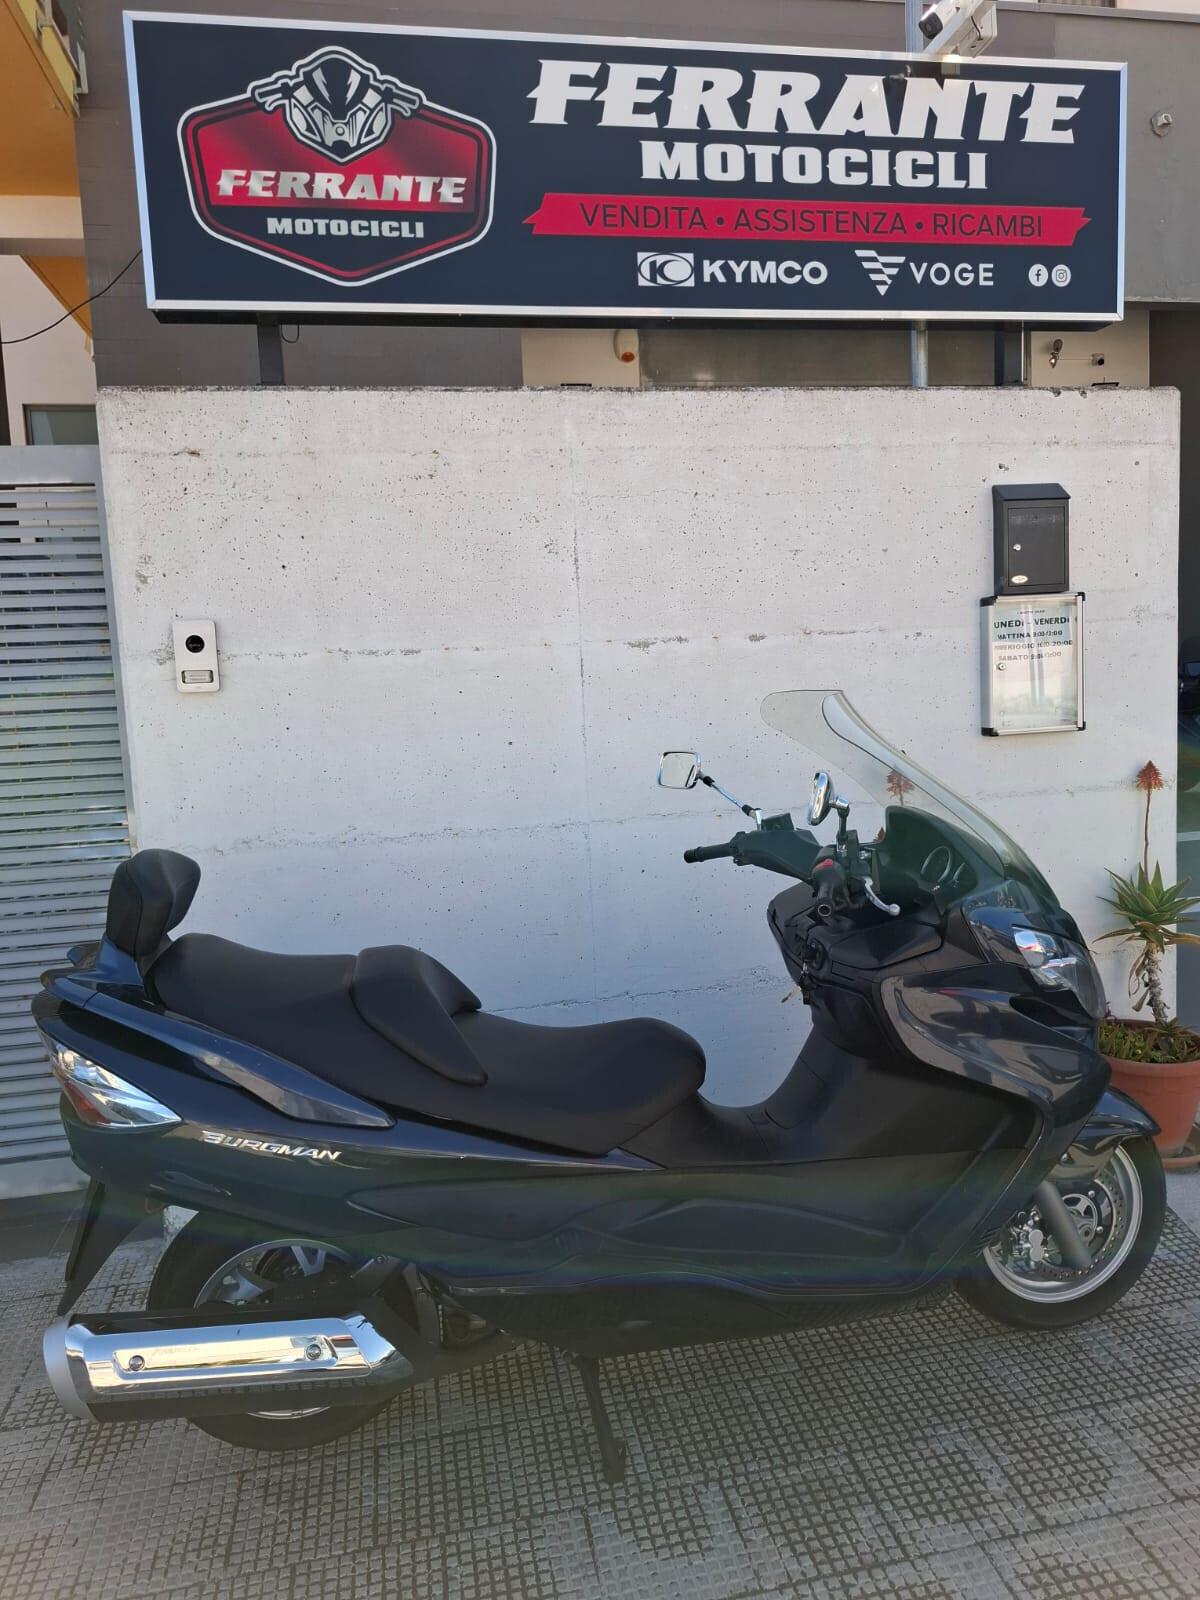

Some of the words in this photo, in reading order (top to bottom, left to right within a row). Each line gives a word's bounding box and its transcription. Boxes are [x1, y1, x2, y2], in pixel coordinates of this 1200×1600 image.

[526, 59, 1085, 144] FERRANTE
[638, 140, 988, 189] MOTOCICLI
[216, 169, 467, 204] FERRANTE
[266, 217, 424, 238] MOTOCICLI
[579, 202, 707, 230] VENDITA
[733, 208, 908, 235] ASSISTENZA
[932, 213, 1042, 238] RICAMBI
[703, 259, 828, 285] KYMCO
[909, 262, 994, 286] VOGE
[201, 1130, 342, 1161] BURGMAN
